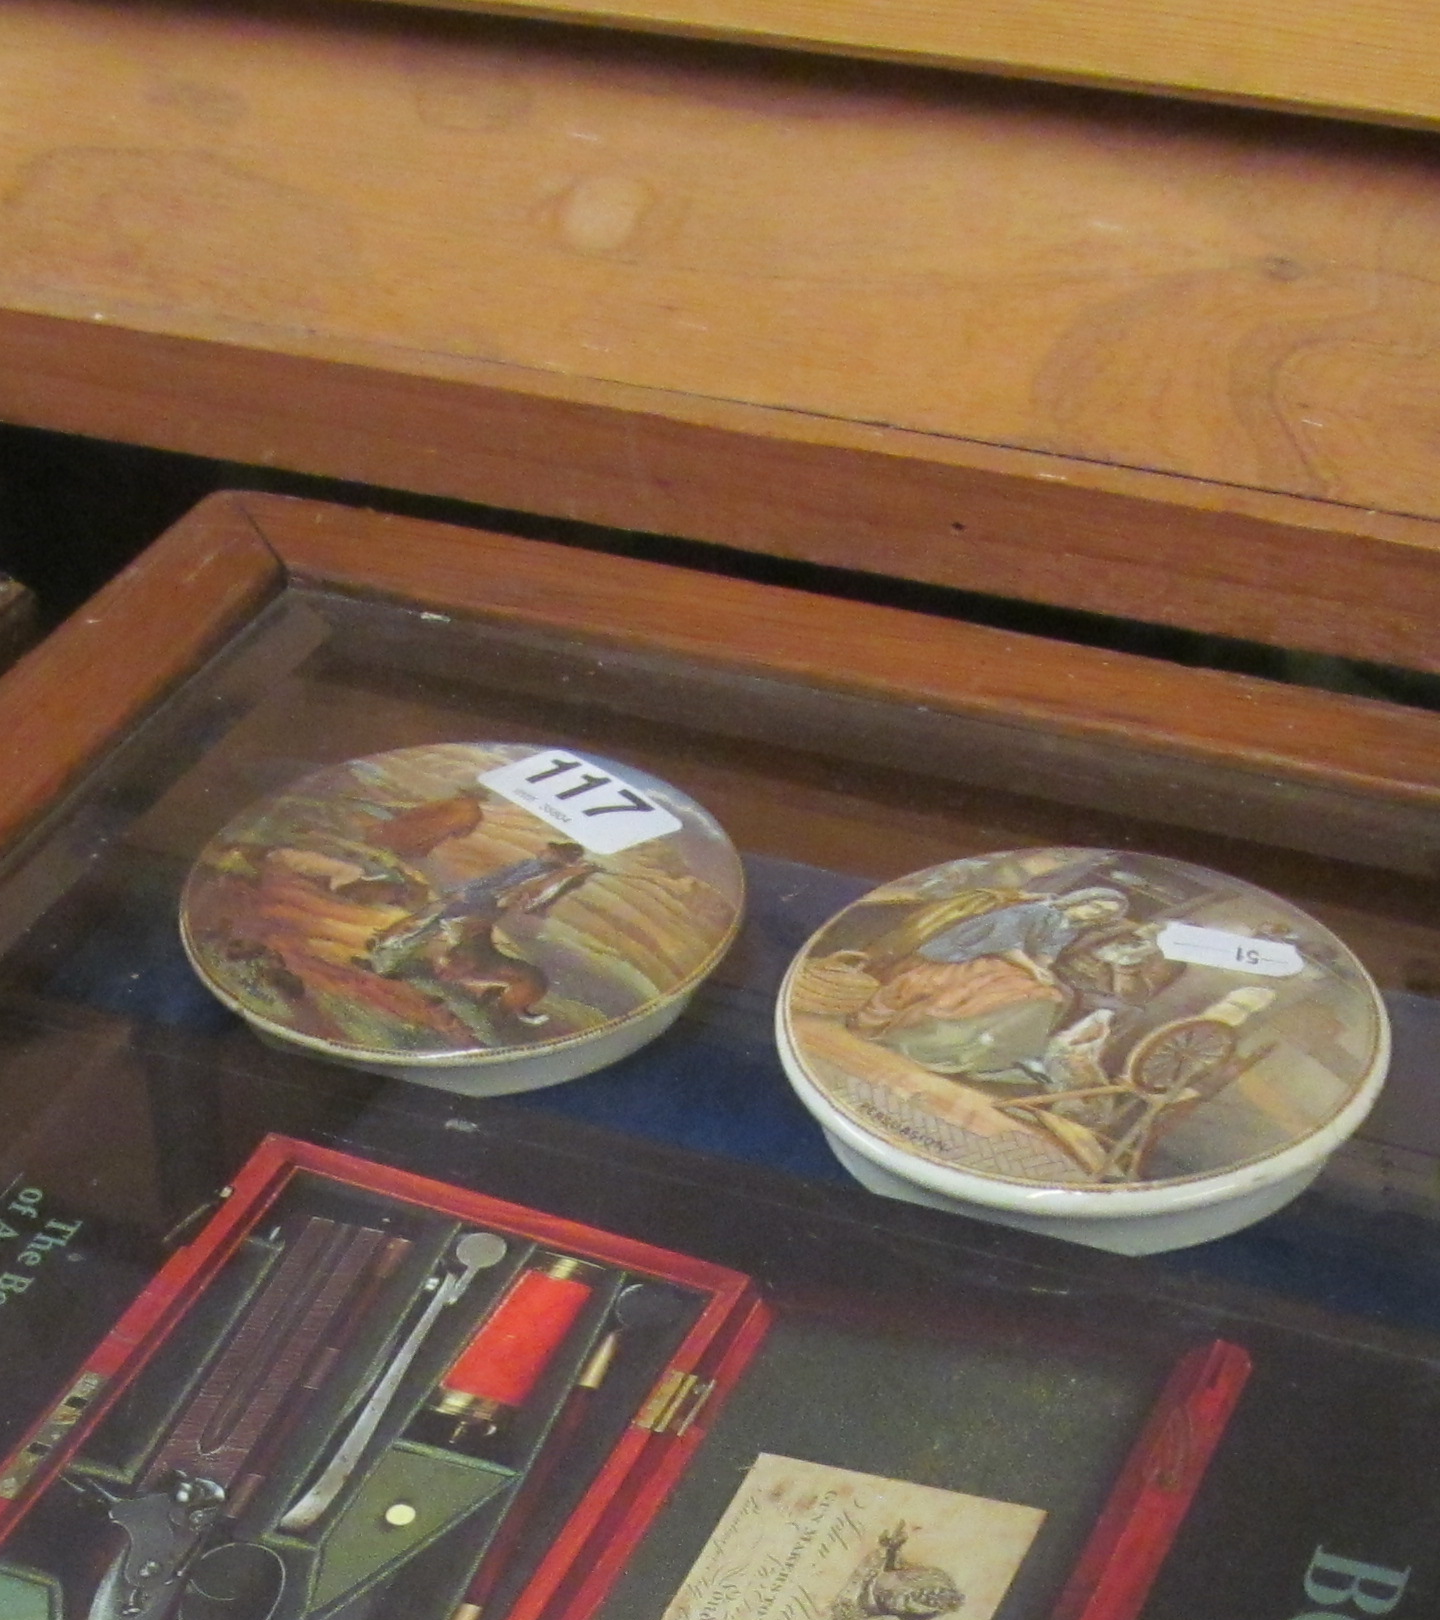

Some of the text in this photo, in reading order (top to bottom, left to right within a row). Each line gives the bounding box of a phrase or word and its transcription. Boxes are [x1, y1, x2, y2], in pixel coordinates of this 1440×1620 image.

[526, 759, 656, 817] 117
[9, 1188, 44, 1218] of
[17, 1218, 83, 1267] The
